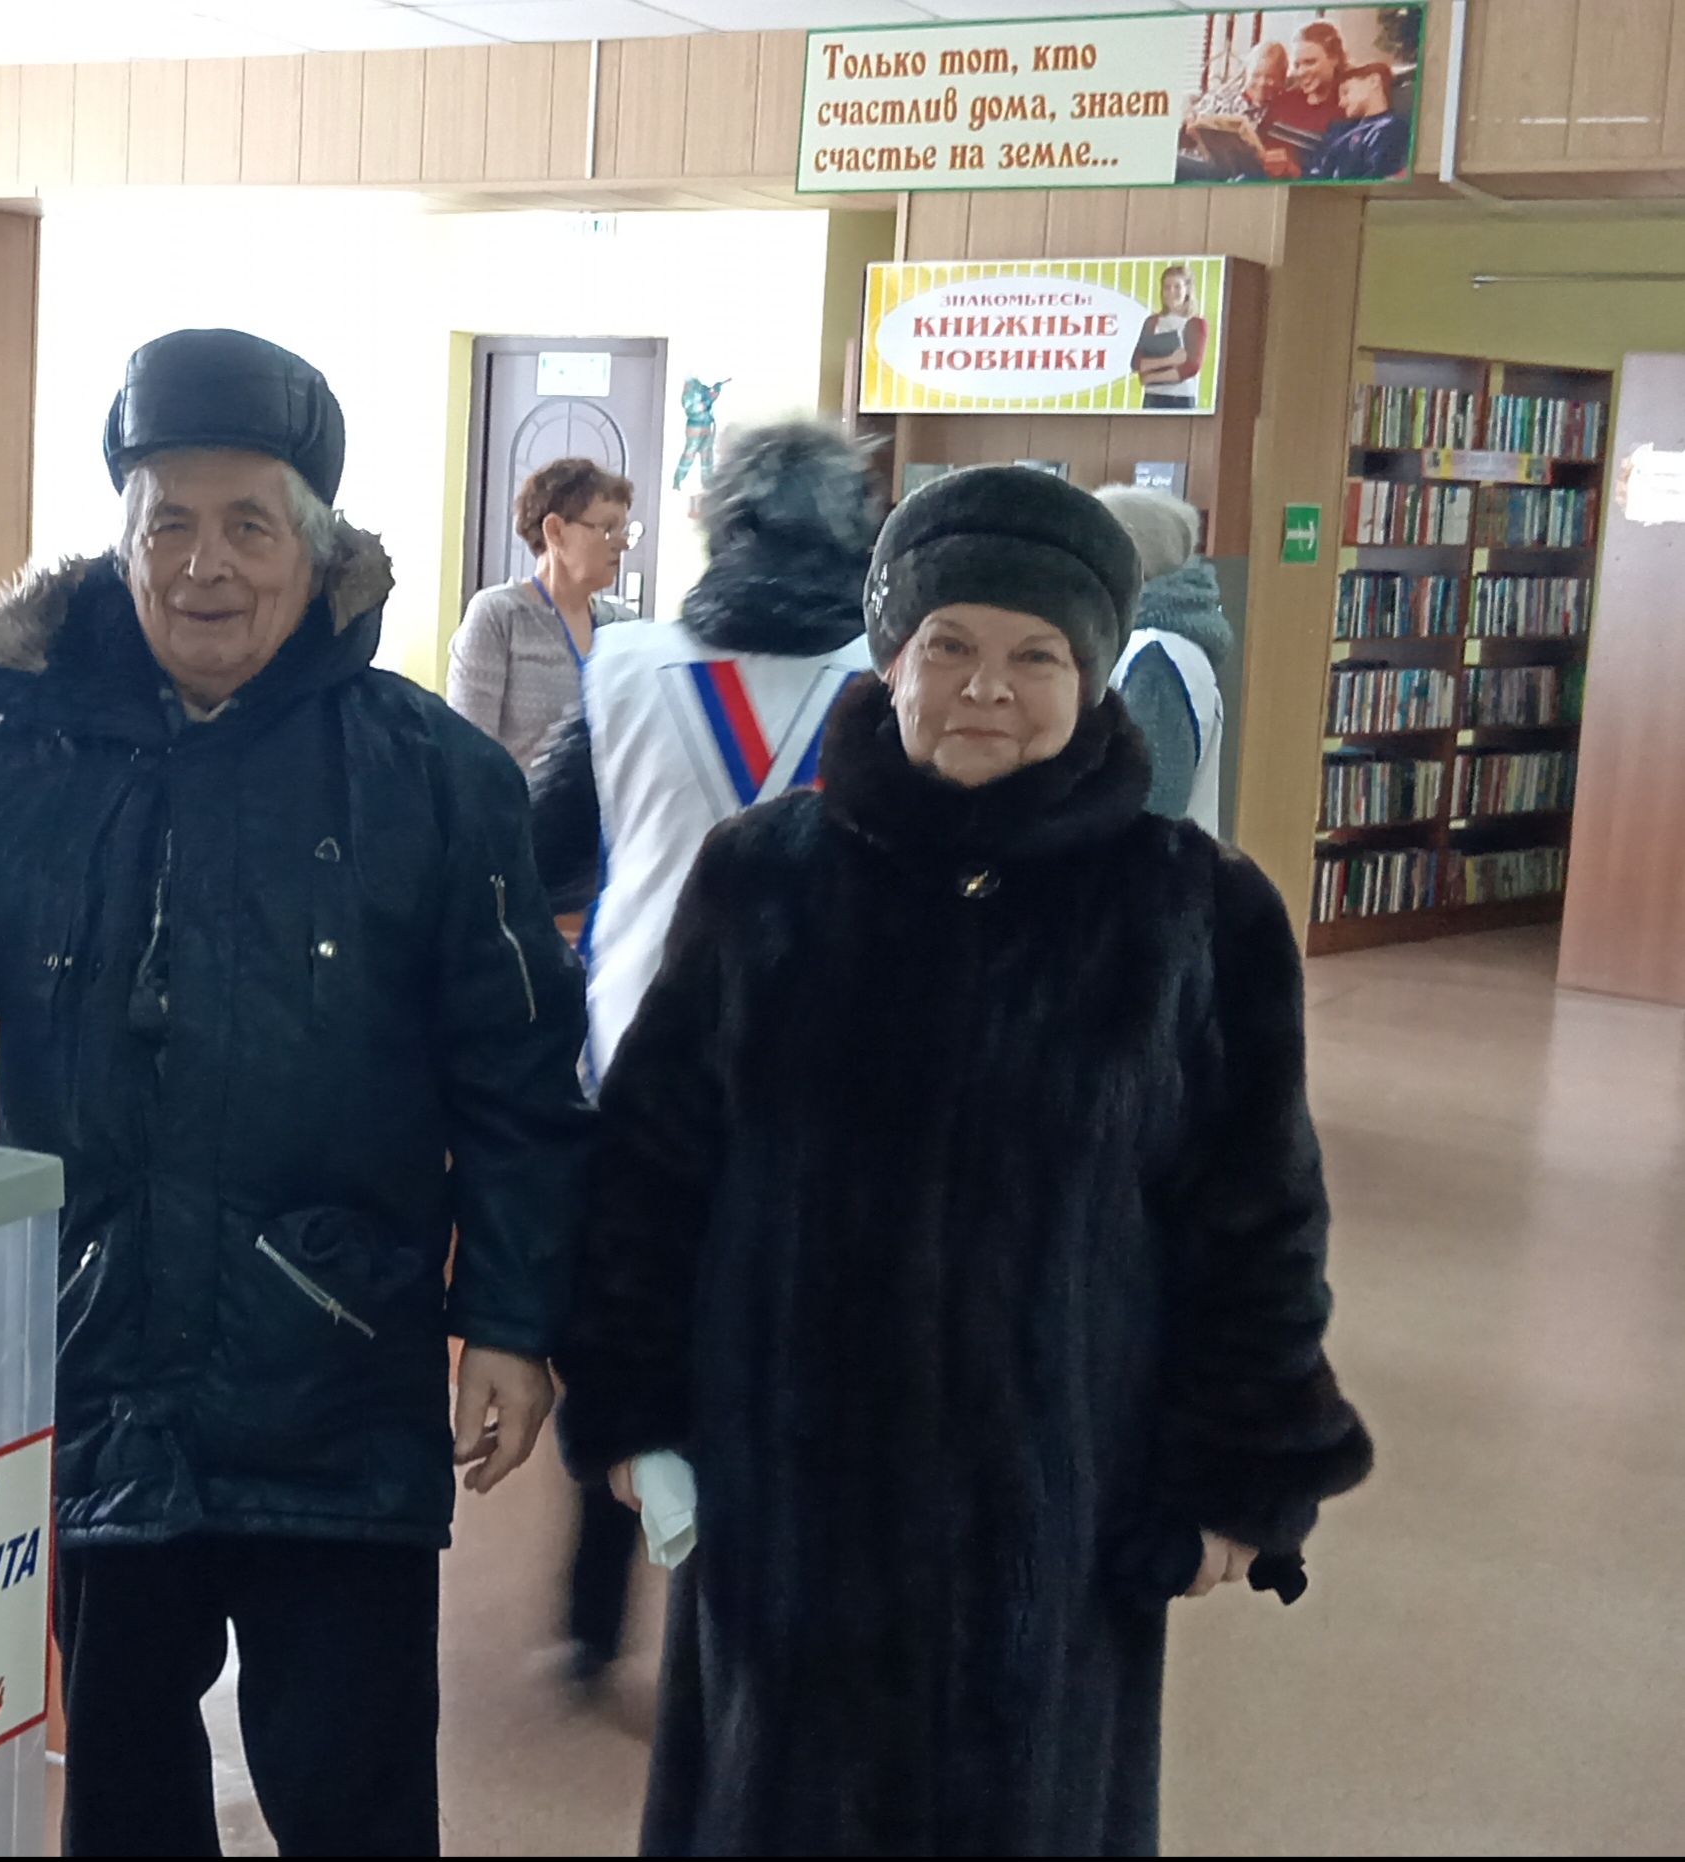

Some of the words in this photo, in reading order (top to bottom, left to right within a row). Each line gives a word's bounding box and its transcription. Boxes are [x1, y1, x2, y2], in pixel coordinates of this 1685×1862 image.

[822, 43, 927, 80] Только
[938, 47, 1018, 77] тот,
[1031, 43, 1098, 72] кто
[816, 86, 959, 126] счастлив
[967, 94, 1057, 132] дома,
[1070, 88, 1170, 120] знает
[813, 145, 937, 173] счастье
[948, 144, 985, 171] на
[998, 141, 1120, 169] земле...
[913, 314, 1120, 338] КНИЖНЫЕ
[920, 348, 1107, 371] НОВИНКИ
